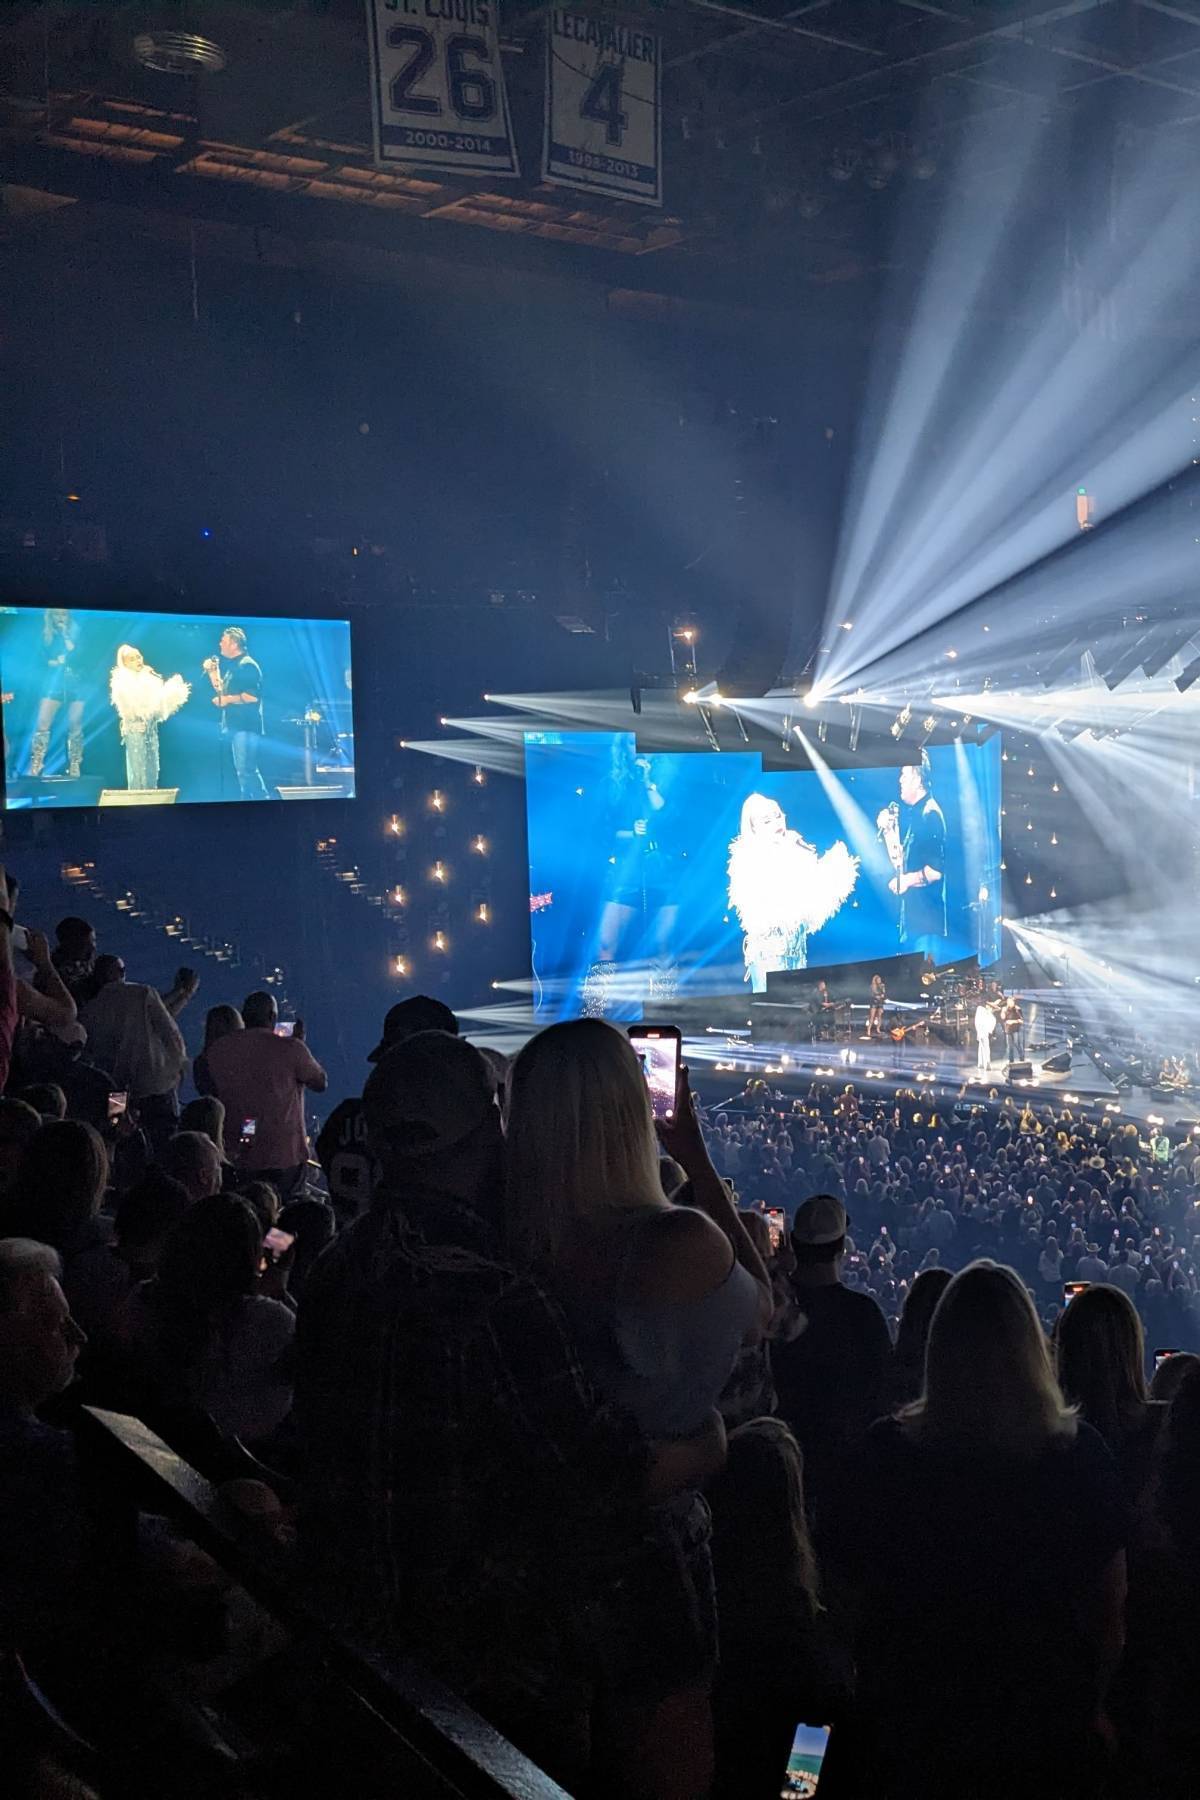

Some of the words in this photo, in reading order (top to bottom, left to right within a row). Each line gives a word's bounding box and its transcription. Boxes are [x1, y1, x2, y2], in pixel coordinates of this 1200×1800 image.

[386, 22, 497, 122] 26
[580, 63, 629, 147] 4
[406, 130, 491, 152] 2000-2014
